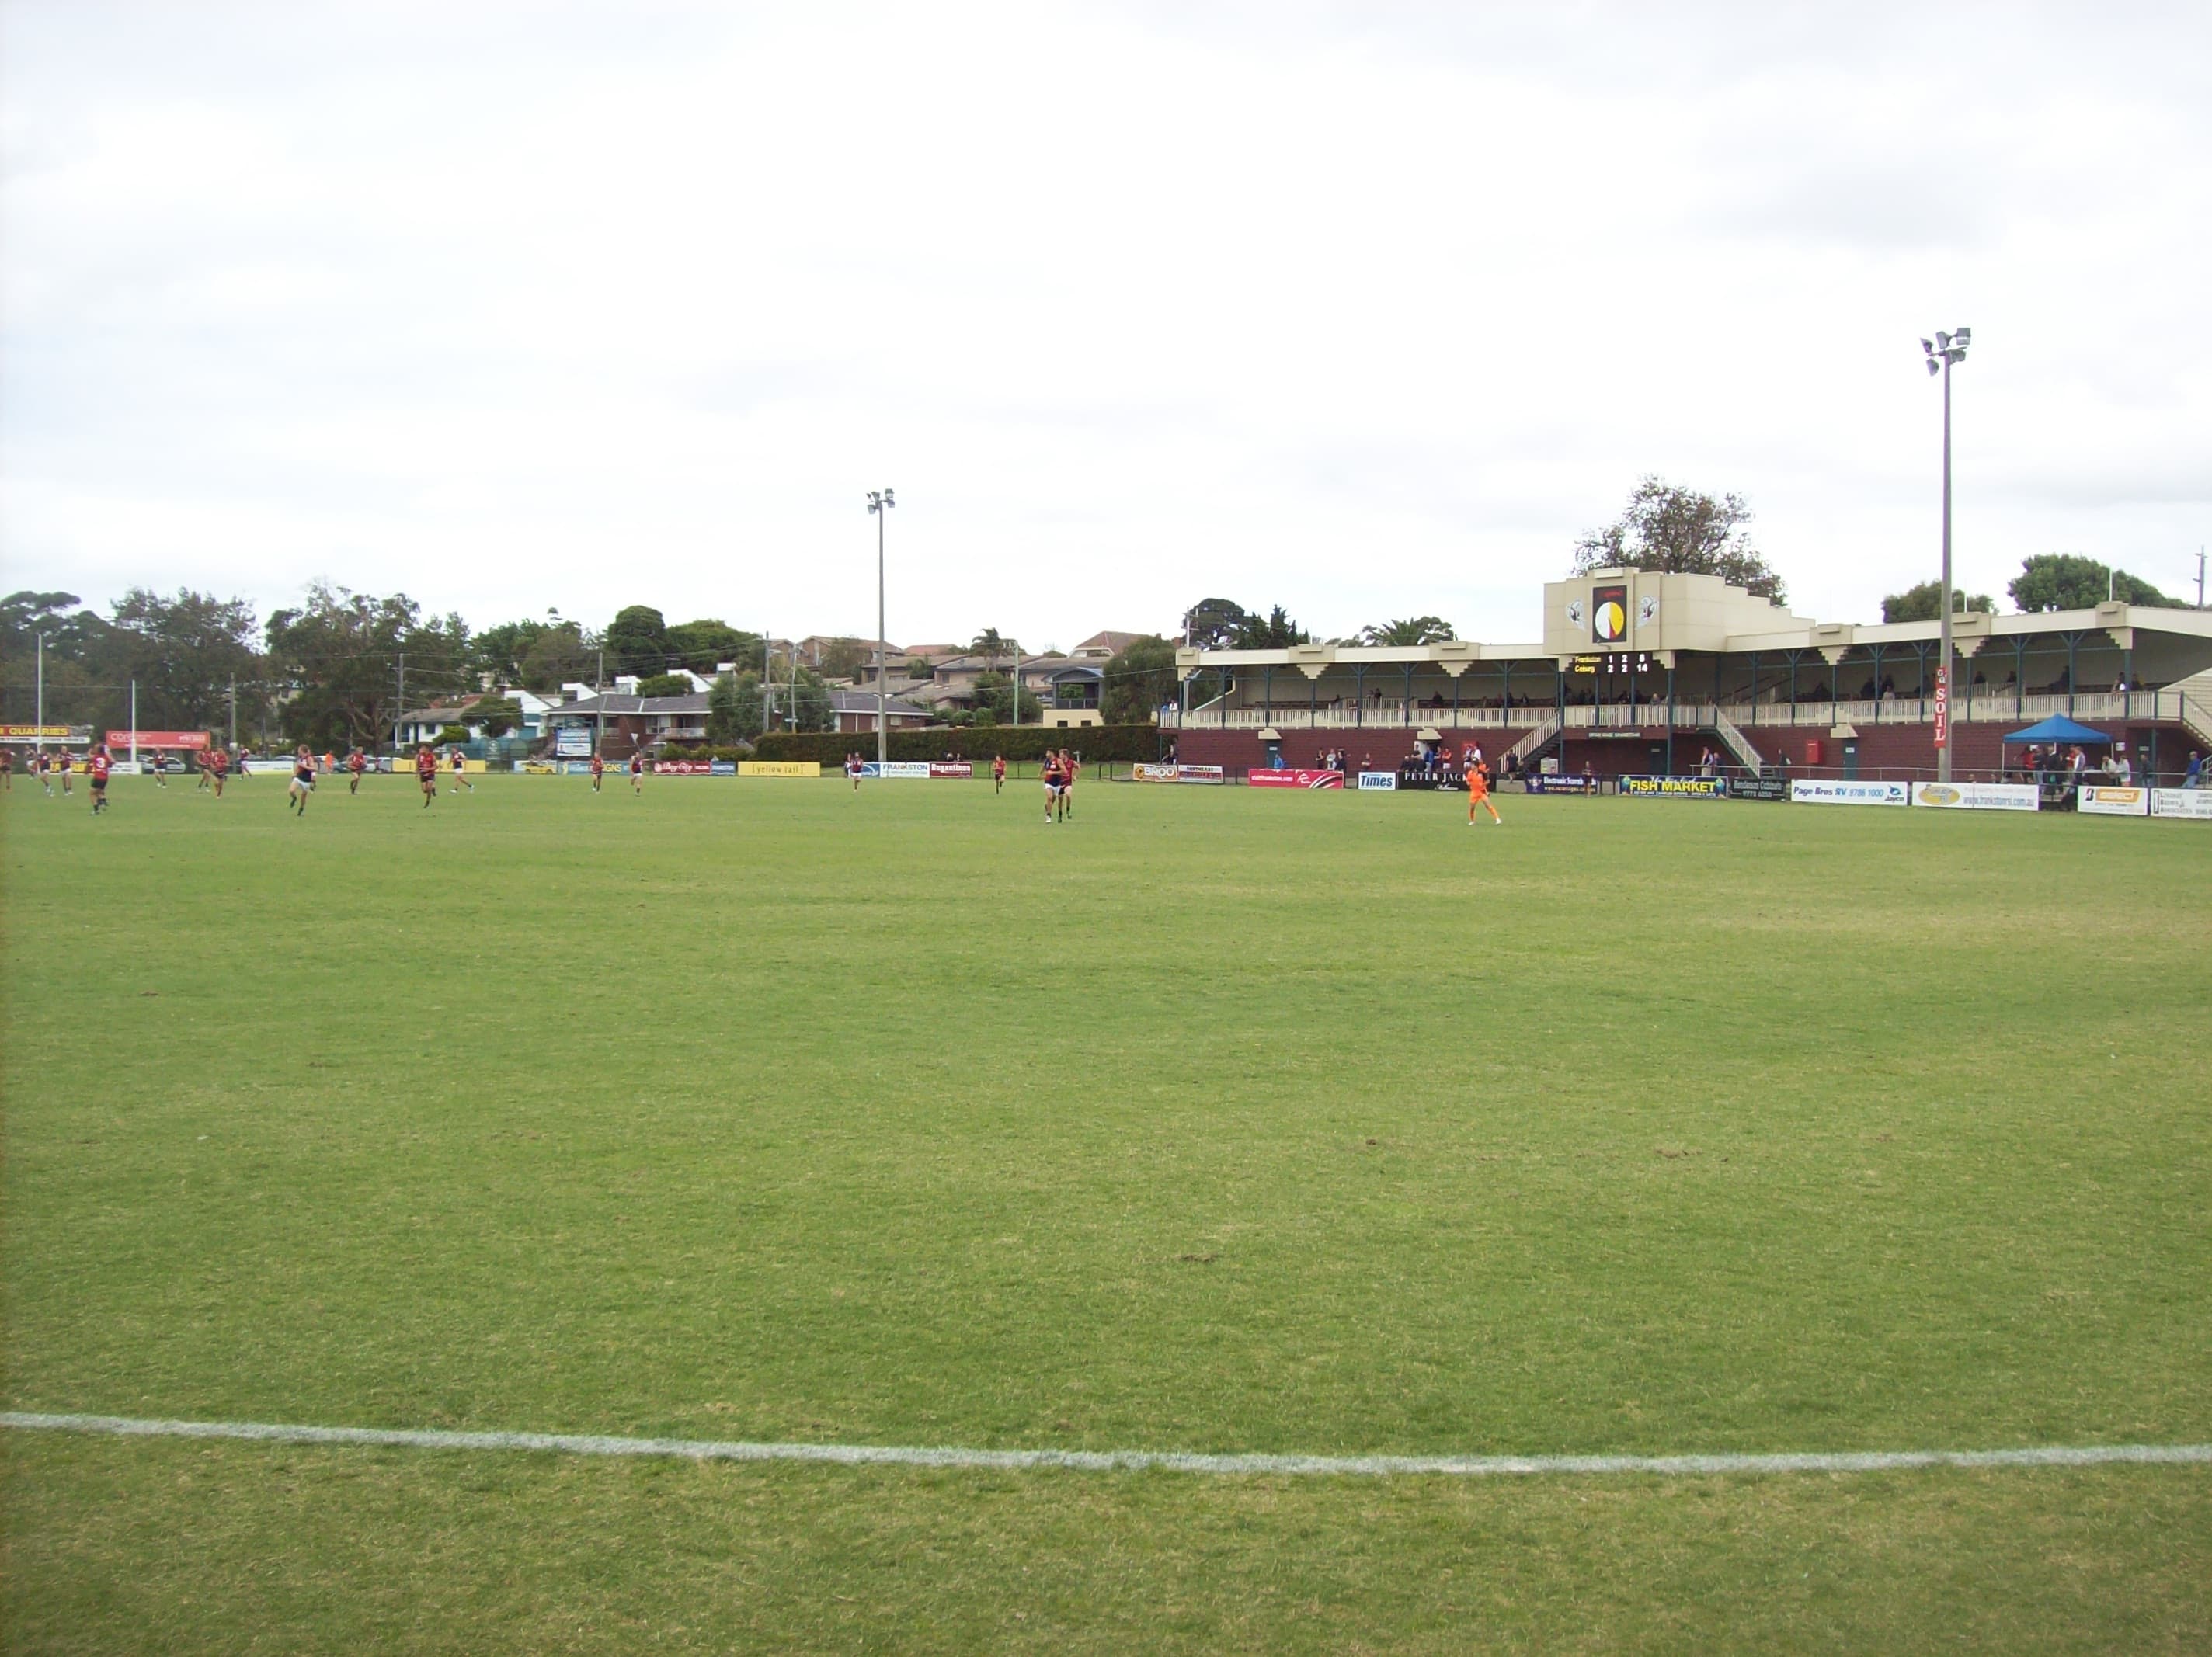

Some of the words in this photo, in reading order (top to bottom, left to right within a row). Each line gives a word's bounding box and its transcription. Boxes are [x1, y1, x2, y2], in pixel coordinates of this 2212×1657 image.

[1622, 655, 1628, 663] 2
[1608, 665, 1613, 673] 2
[1622, 664, 1628, 673] 2
[1636, 664, 1648, 672] 14
[96, 757, 106, 768] 3
[1361, 775, 1393, 787] Times
[1405, 772, 1438, 781] PETER
[1630, 780, 1658, 791] FISH
[1661, 781, 1716, 793] MARKET
[1793, 786, 1813, 797] Page
[1814, 787, 1833, 796] Bros
[1867, 789, 1884, 797] 1000
